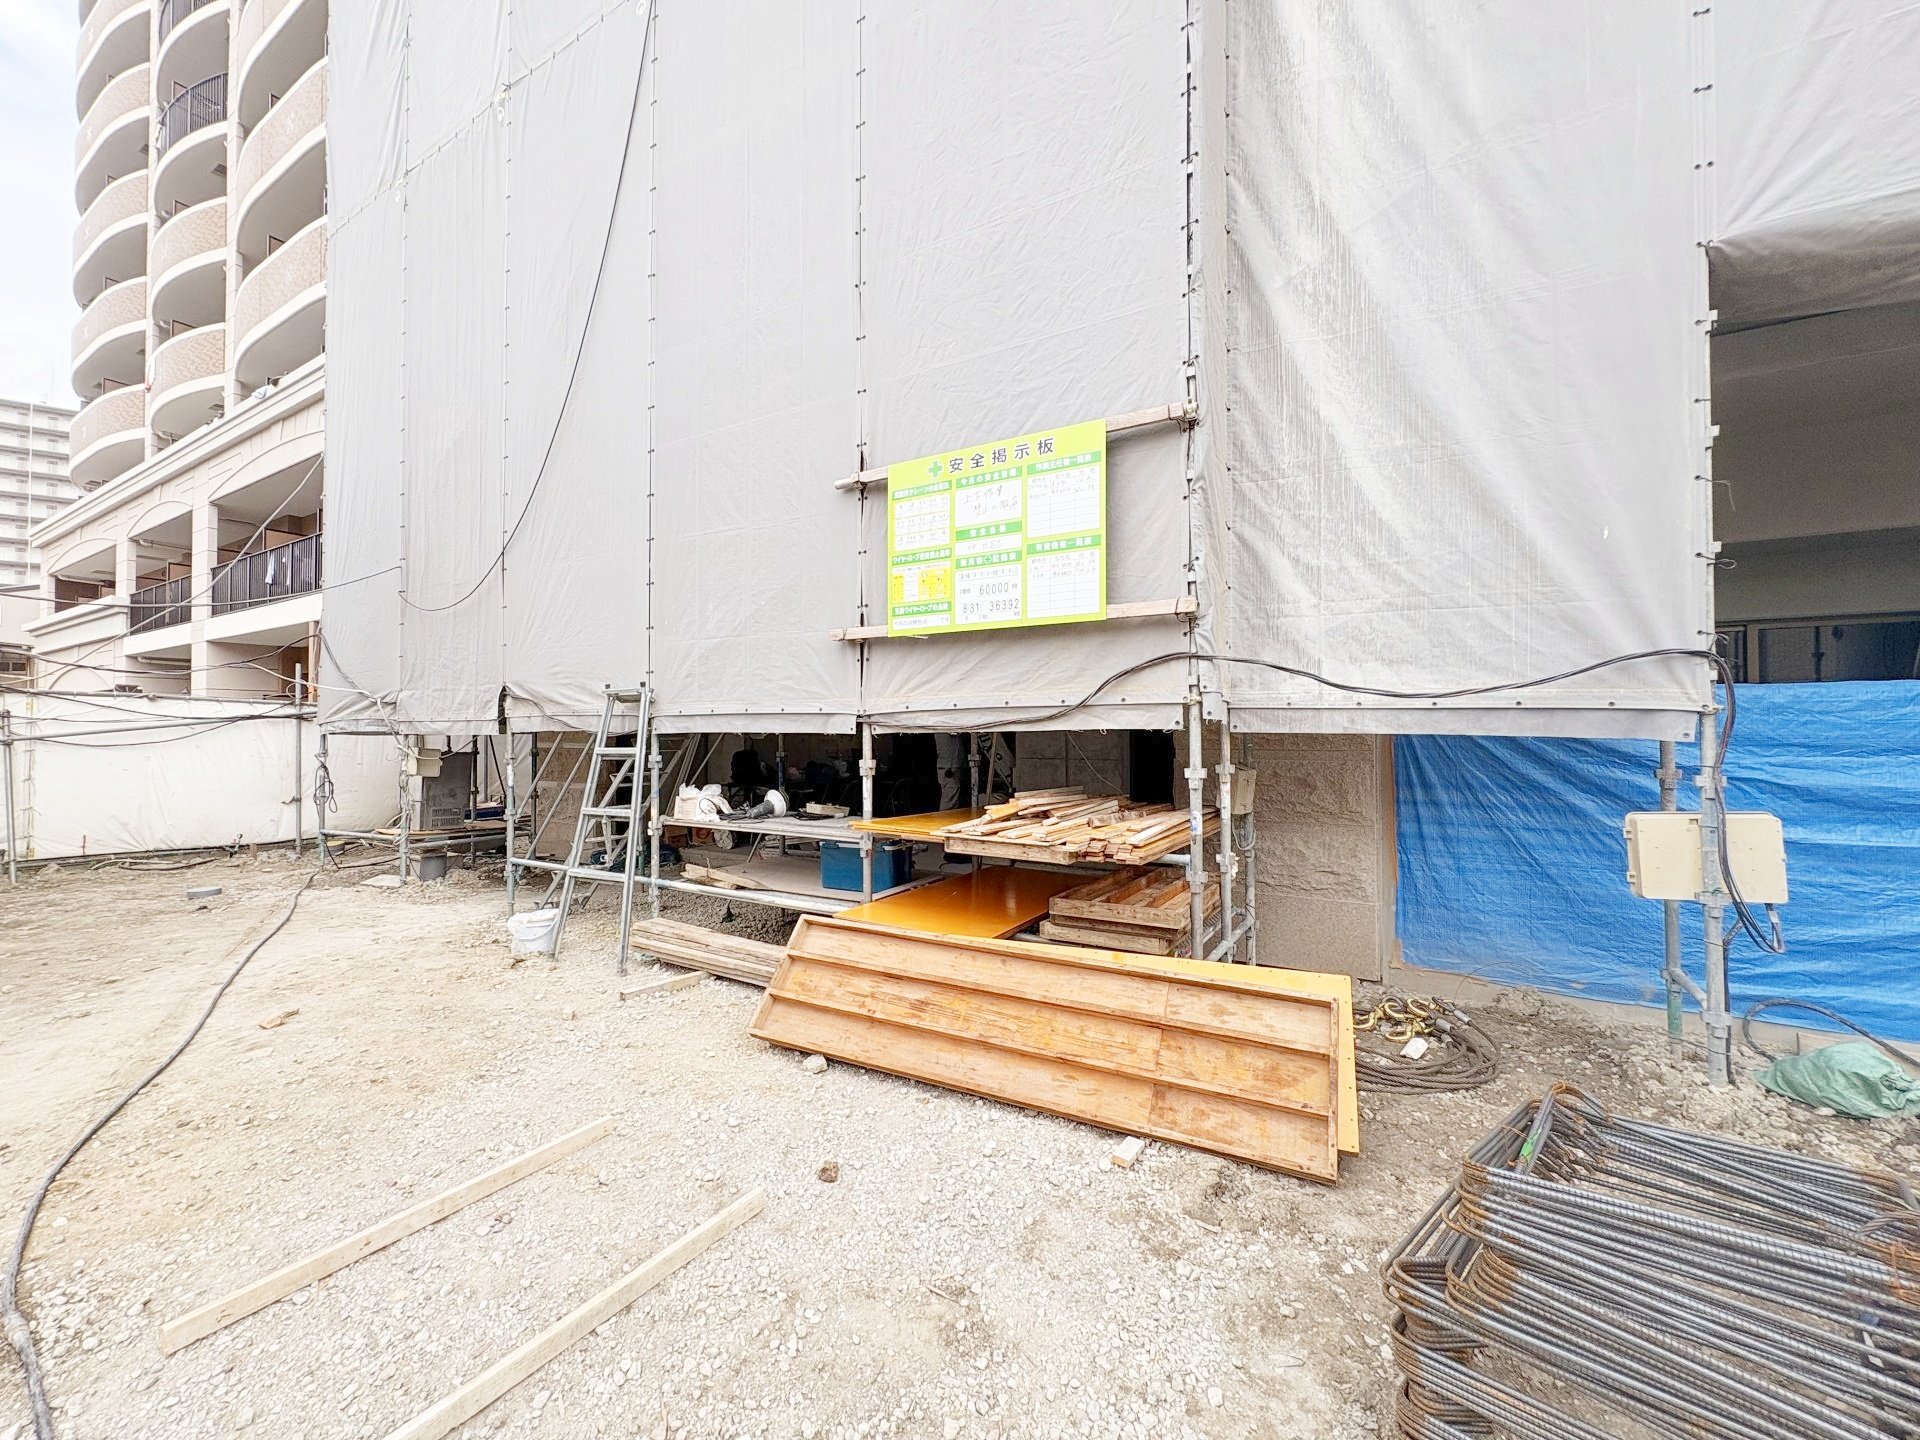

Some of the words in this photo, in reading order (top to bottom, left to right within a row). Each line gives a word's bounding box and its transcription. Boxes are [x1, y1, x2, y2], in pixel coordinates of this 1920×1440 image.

[949, 438, 1054, 474] 安全掲示板
[979, 582, 1009, 595] 60000
[963, 602, 979, 614] 831
[989, 598, 1019, 612] 36392
